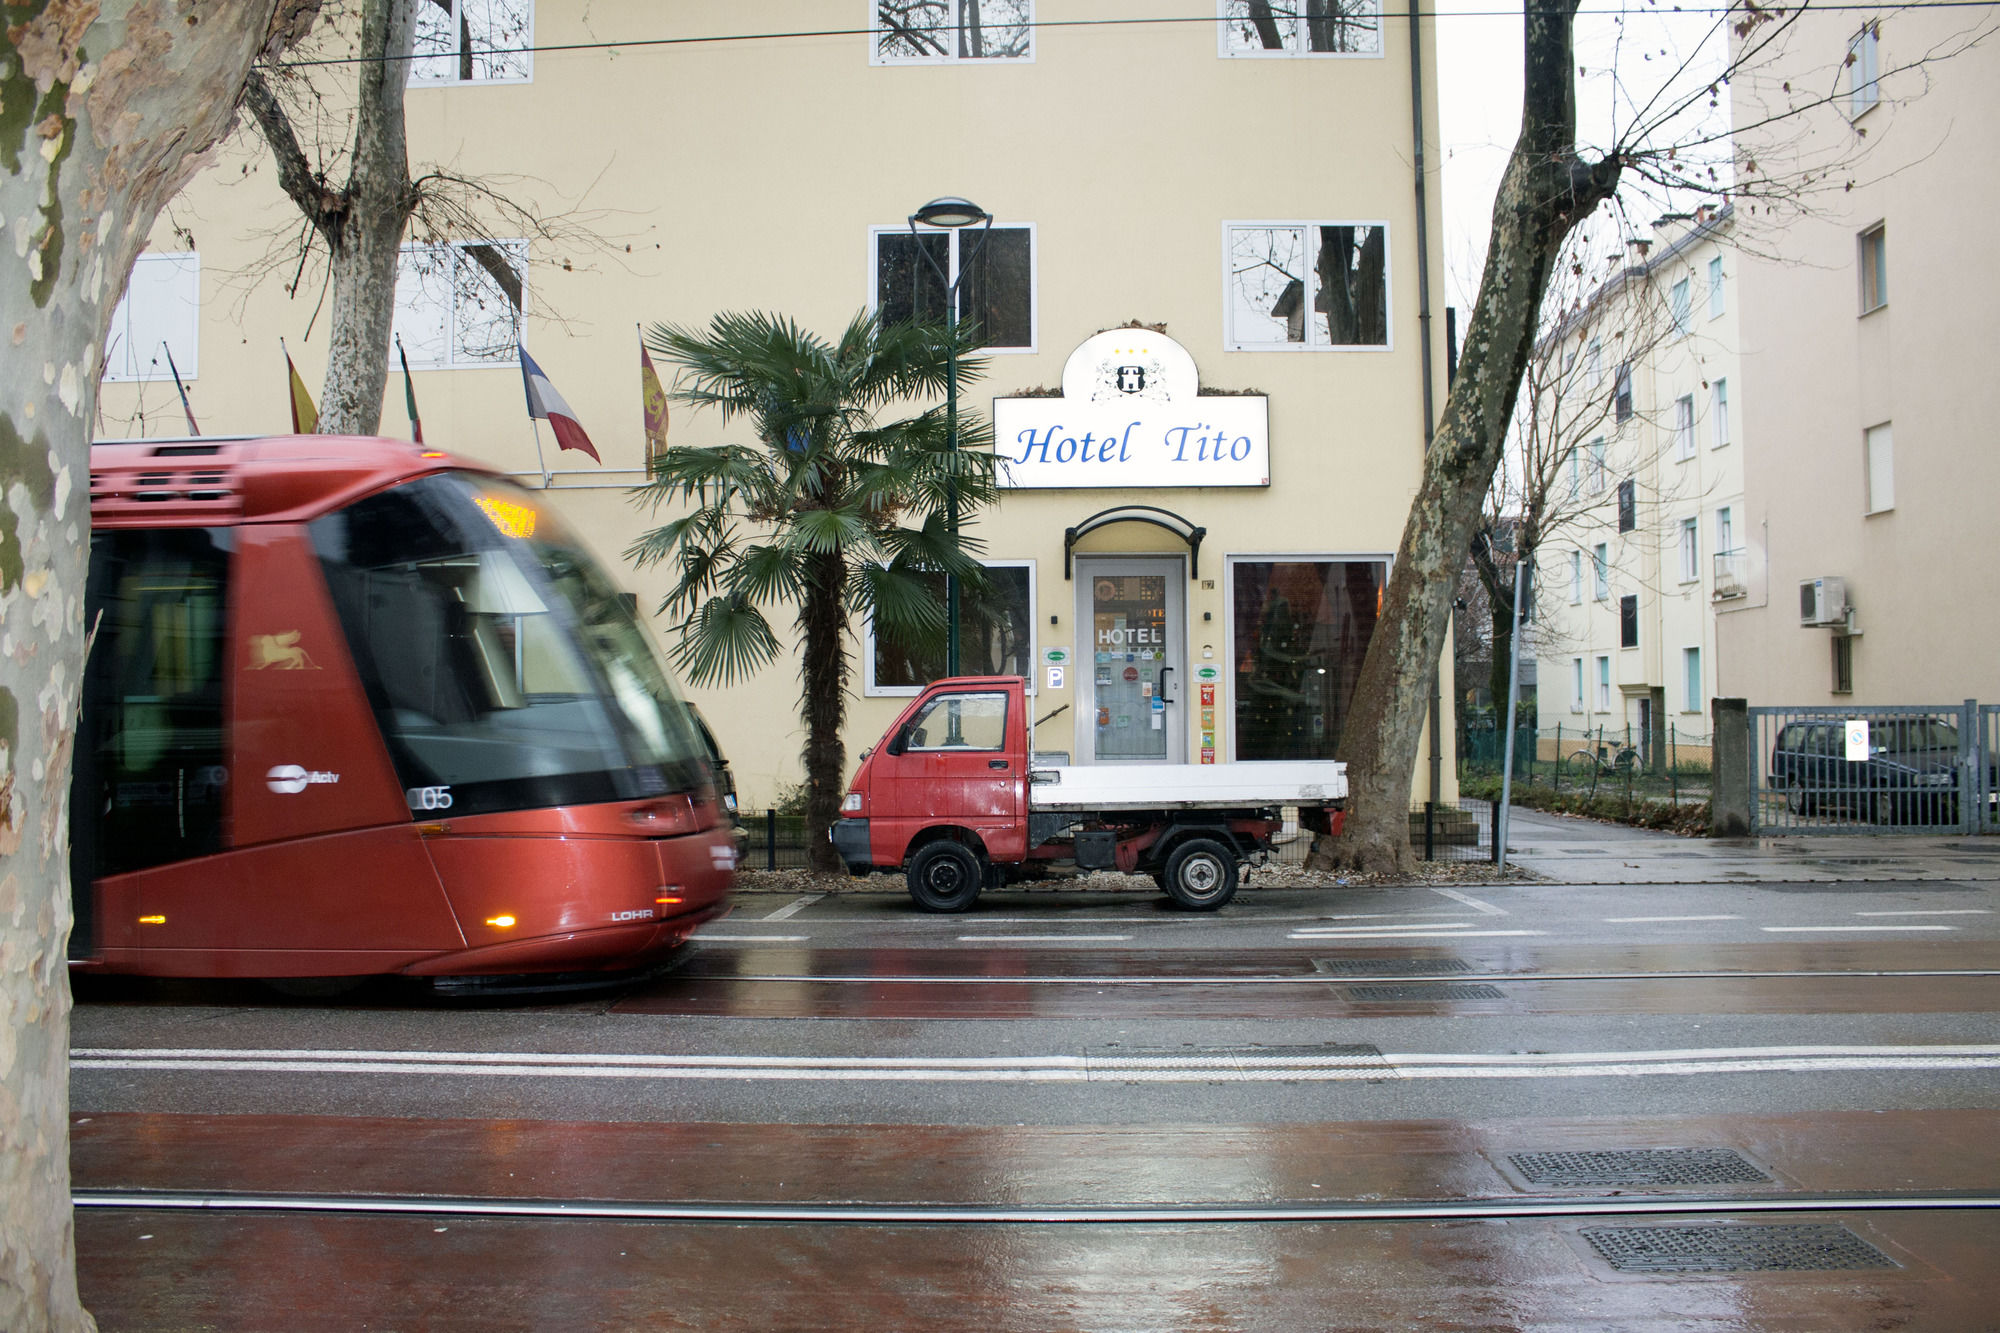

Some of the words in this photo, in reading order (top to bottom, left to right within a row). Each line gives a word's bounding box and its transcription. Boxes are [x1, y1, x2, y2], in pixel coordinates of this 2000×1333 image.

[1013, 421, 1141, 464] Hotel
[1164, 422, 1251, 462] Tito
[1098, 628, 1162, 644] HOTEL
[611, 908, 654, 922] LOHR
